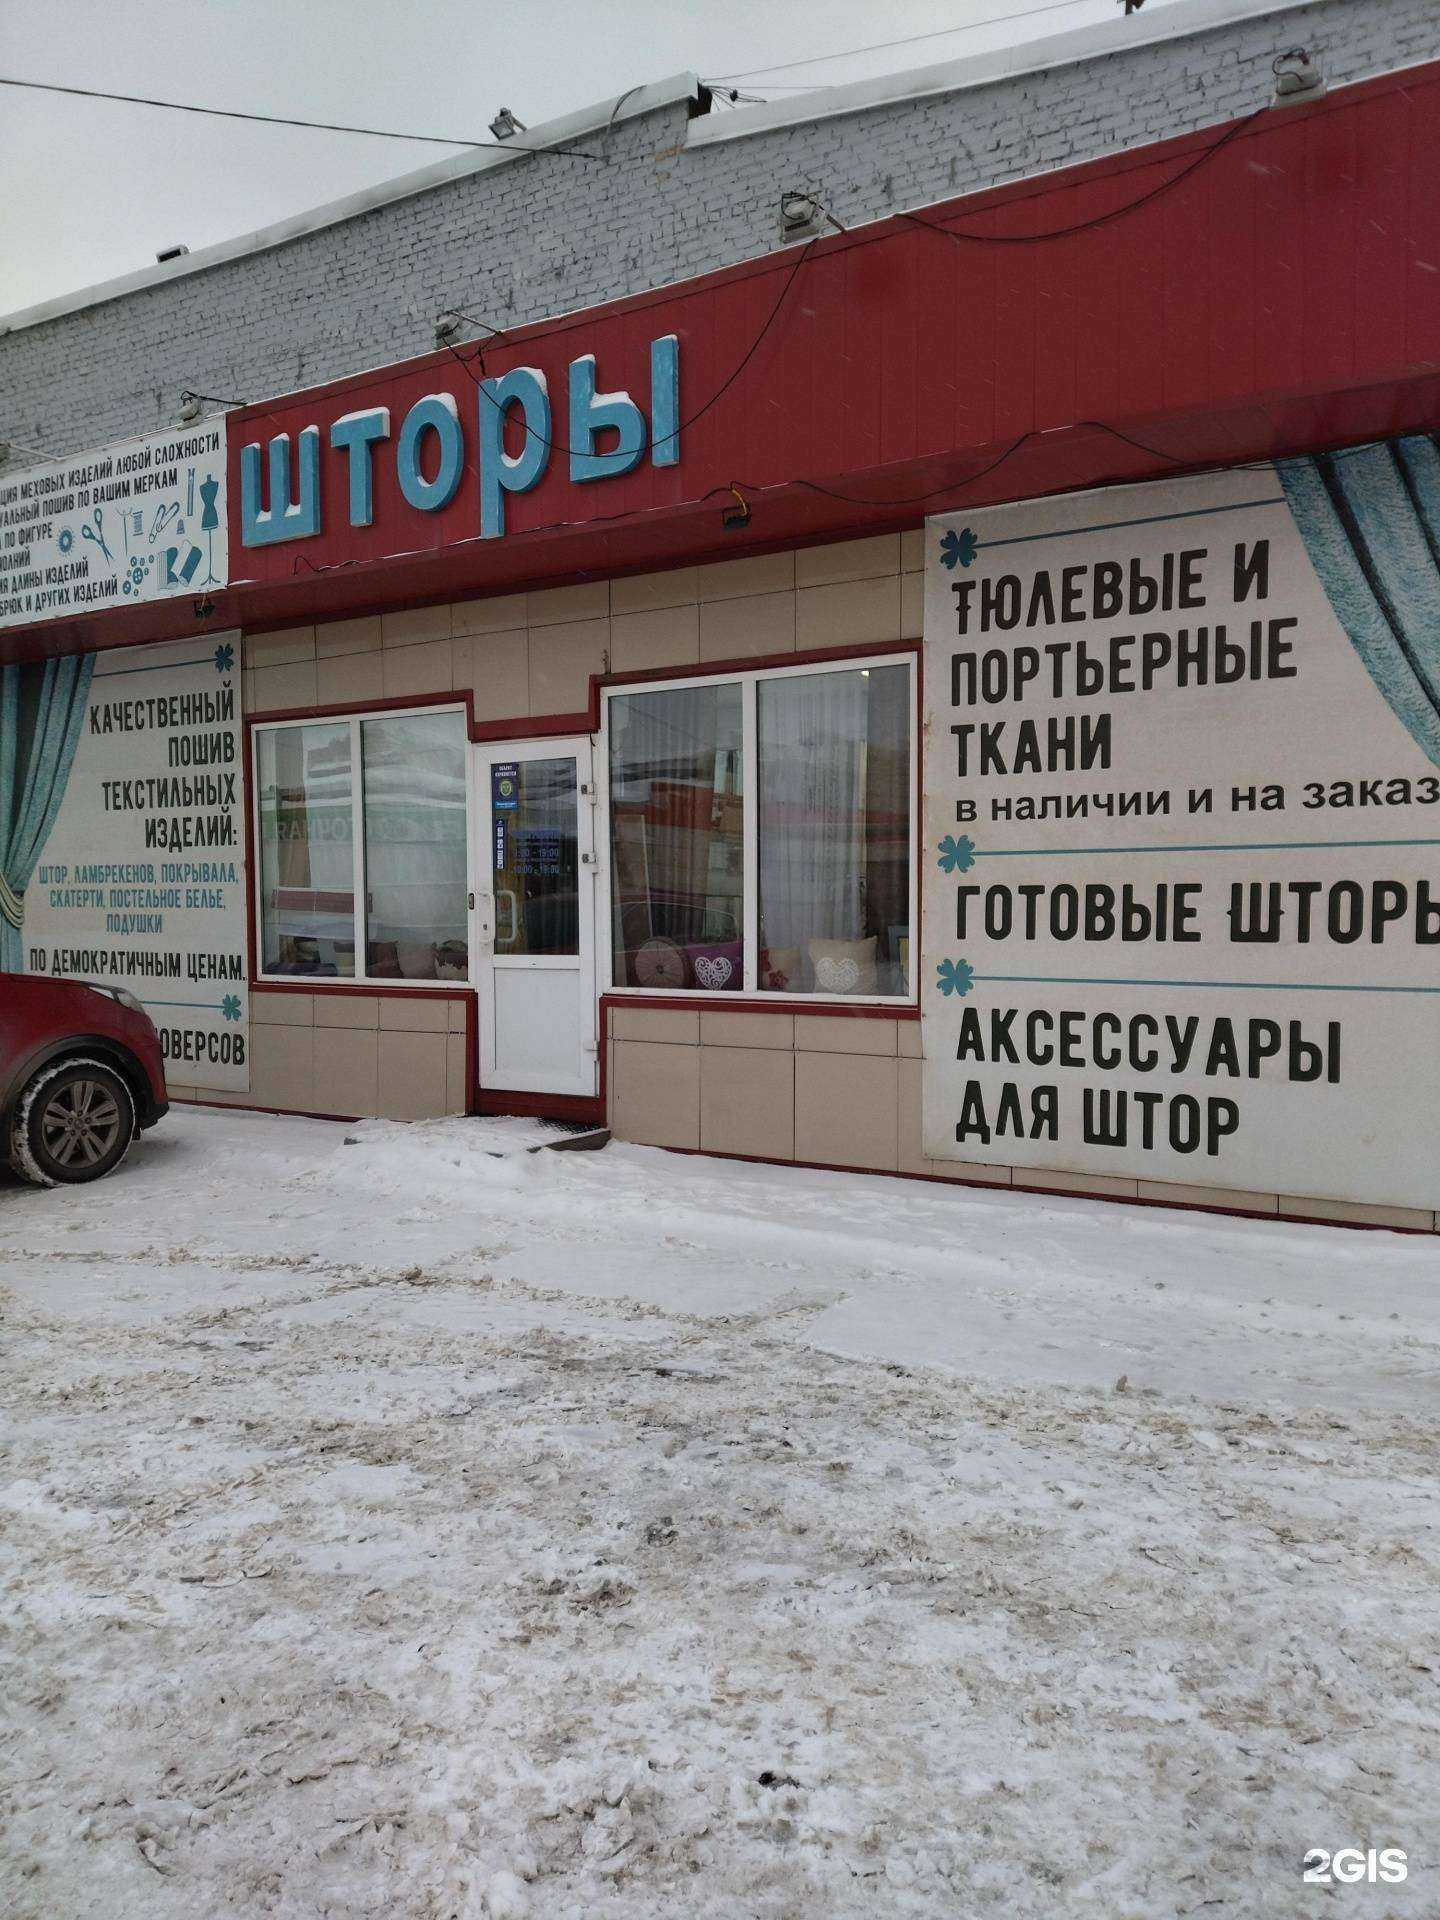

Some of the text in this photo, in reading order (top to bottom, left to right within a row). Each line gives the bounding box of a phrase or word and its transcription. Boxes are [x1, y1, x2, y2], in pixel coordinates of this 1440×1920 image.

[21, 473, 66, 500] МЕХОВЫХ
[68, 456, 113, 487] ИЗДЕЛИЙ
[116, 445, 151, 475] ЛЮБОЙ
[155, 432, 220, 464] СЛОЖНОСТИ
[42, 492, 74, 517] ПОШИВ
[78, 489, 90, 509] ПО
[93, 482, 131, 505] ВАШИМ
[134, 468, 178, 493] МЕРКАМ
[5, 521, 53, 549] ПО ФИГУРЕ
[11, 570, 42, 595] ДЛИНЫ
[46, 557, 89, 587] ИЗДЕЛИЙ
[25, 595, 32, 611] И
[35, 587, 70, 613] ДРУГИХ
[73, 575, 118, 604] ИЗДЕЛИЙ
[951, 539, 1270, 634] ТЮЛЕВЫЕ И
[951, 617, 1298, 706] ПОРТЬЕРНЫЕ
[90, 680, 234, 735] КАЧЕСТВЕННЫЙ
[168, 731, 235, 767] ПОШИВ
[951, 713, 1112, 777] ТКАНИ
[102, 773, 236, 811] ТЕКСТИЛЬНЫХ
[956, 777, 1440, 822] в наличии и на заказ
[145, 806, 238, 852] ИЗДЕЛИЙ:
[110, 889, 181, 908] ПОСТЕЛЬНОЕ
[956, 883, 1202, 942] ГОТОВЫЕ
[106, 914, 163, 935] ПОДУШКИ
[30, 948, 46, 971] ПО
[51, 949, 181, 978] ДЕМОКРАТИЧНЫМ
[956, 1007, 1341, 1083] АКСЕССУАРЫ
[955, 1080, 1240, 1156] ДЛЯ ШТОР
